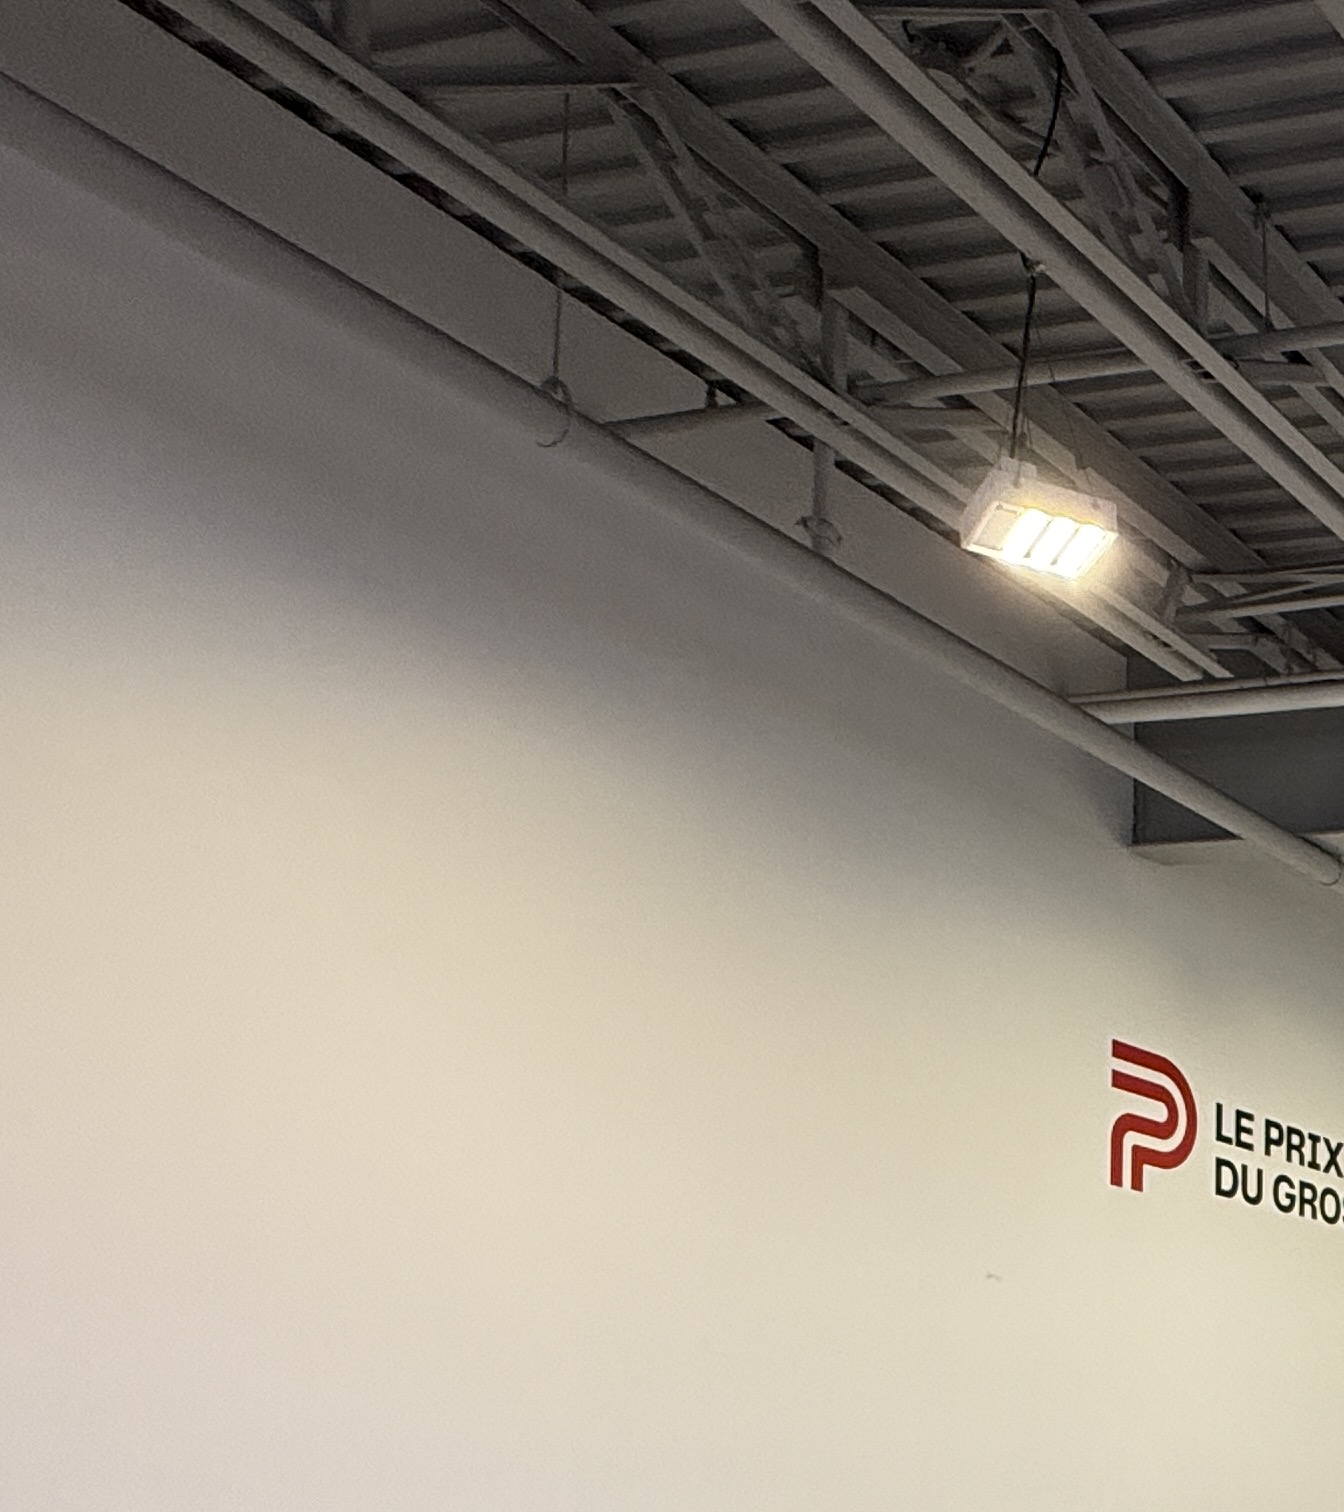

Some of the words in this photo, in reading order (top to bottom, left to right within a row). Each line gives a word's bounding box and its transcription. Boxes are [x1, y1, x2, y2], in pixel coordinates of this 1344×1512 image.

[1215, 1102, 1255, 1152] LE
[1264, 1117, 1344, 1179] PRIX
[1215, 1156, 1264, 1206] DU
